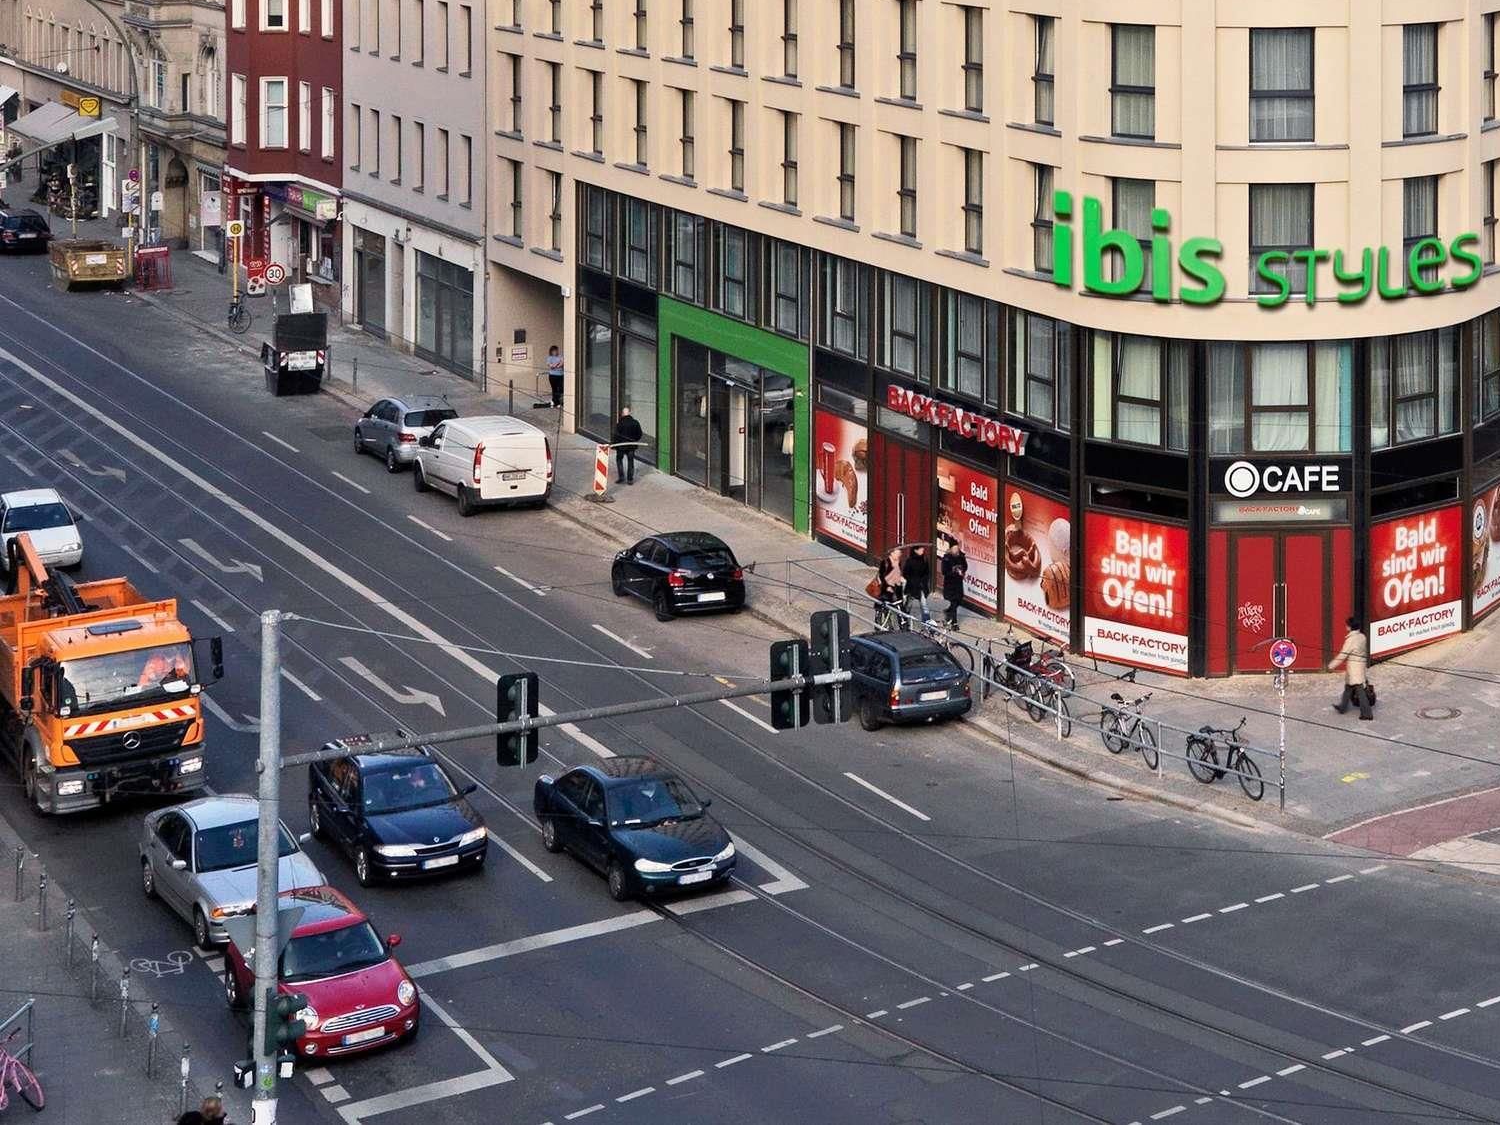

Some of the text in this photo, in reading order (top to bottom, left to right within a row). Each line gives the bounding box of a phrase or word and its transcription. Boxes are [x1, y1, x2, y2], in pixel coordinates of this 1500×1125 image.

[1053, 190, 1227, 305] ibis
[268, 269, 281, 279] 30
[970, 481, 988, 501] Bald
[1262, 465, 1340, 492] CAFE
[961, 495, 985, 520] haben
[1115, 529, 1163, 561] Bald
[1395, 517, 1437, 551] Bald
[1101, 554, 1177, 586] sind wir
[1382, 542, 1448, 577] sind wir
[1102, 578, 1174, 618] Ofen!
[1383, 566, 1446, 608] Ofen!
